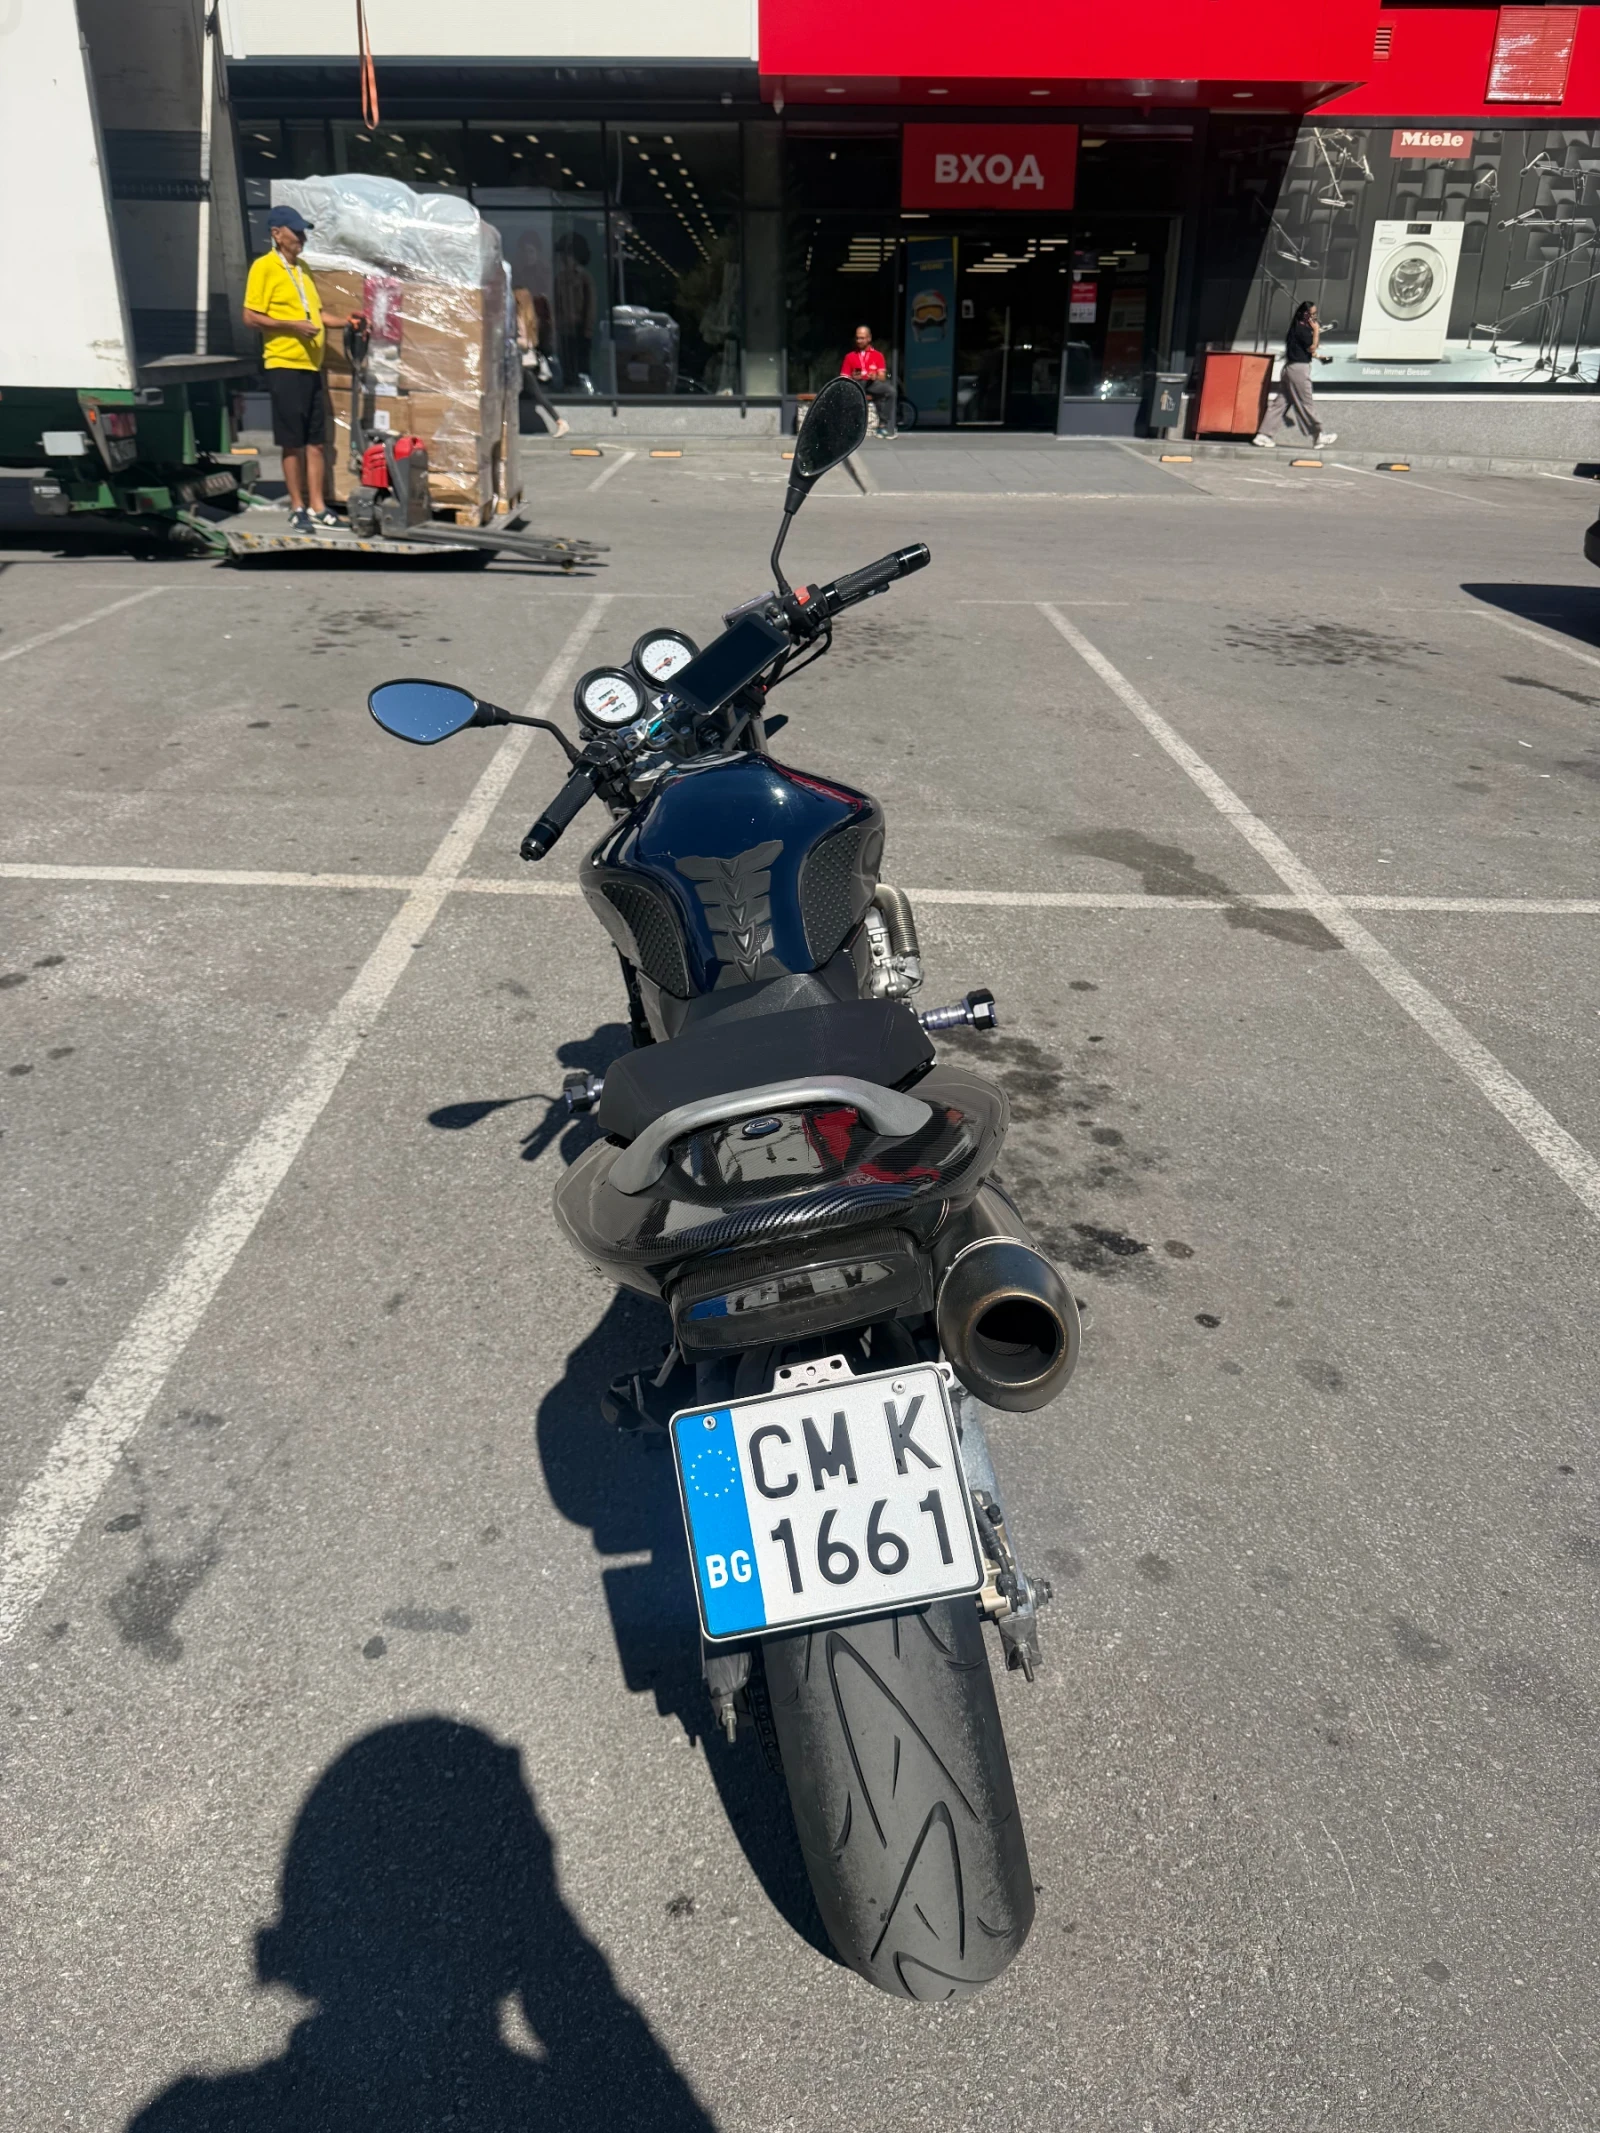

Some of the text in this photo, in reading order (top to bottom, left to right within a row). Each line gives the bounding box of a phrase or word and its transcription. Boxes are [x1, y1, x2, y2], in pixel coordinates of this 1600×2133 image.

[1401, 131, 1464, 147] Miele
[935, 154, 1045, 190] ВХОД
[749, 1395, 942, 1499] CM K
[770, 1488, 954, 1594] 1661
[705, 1549, 753, 1589] BG
